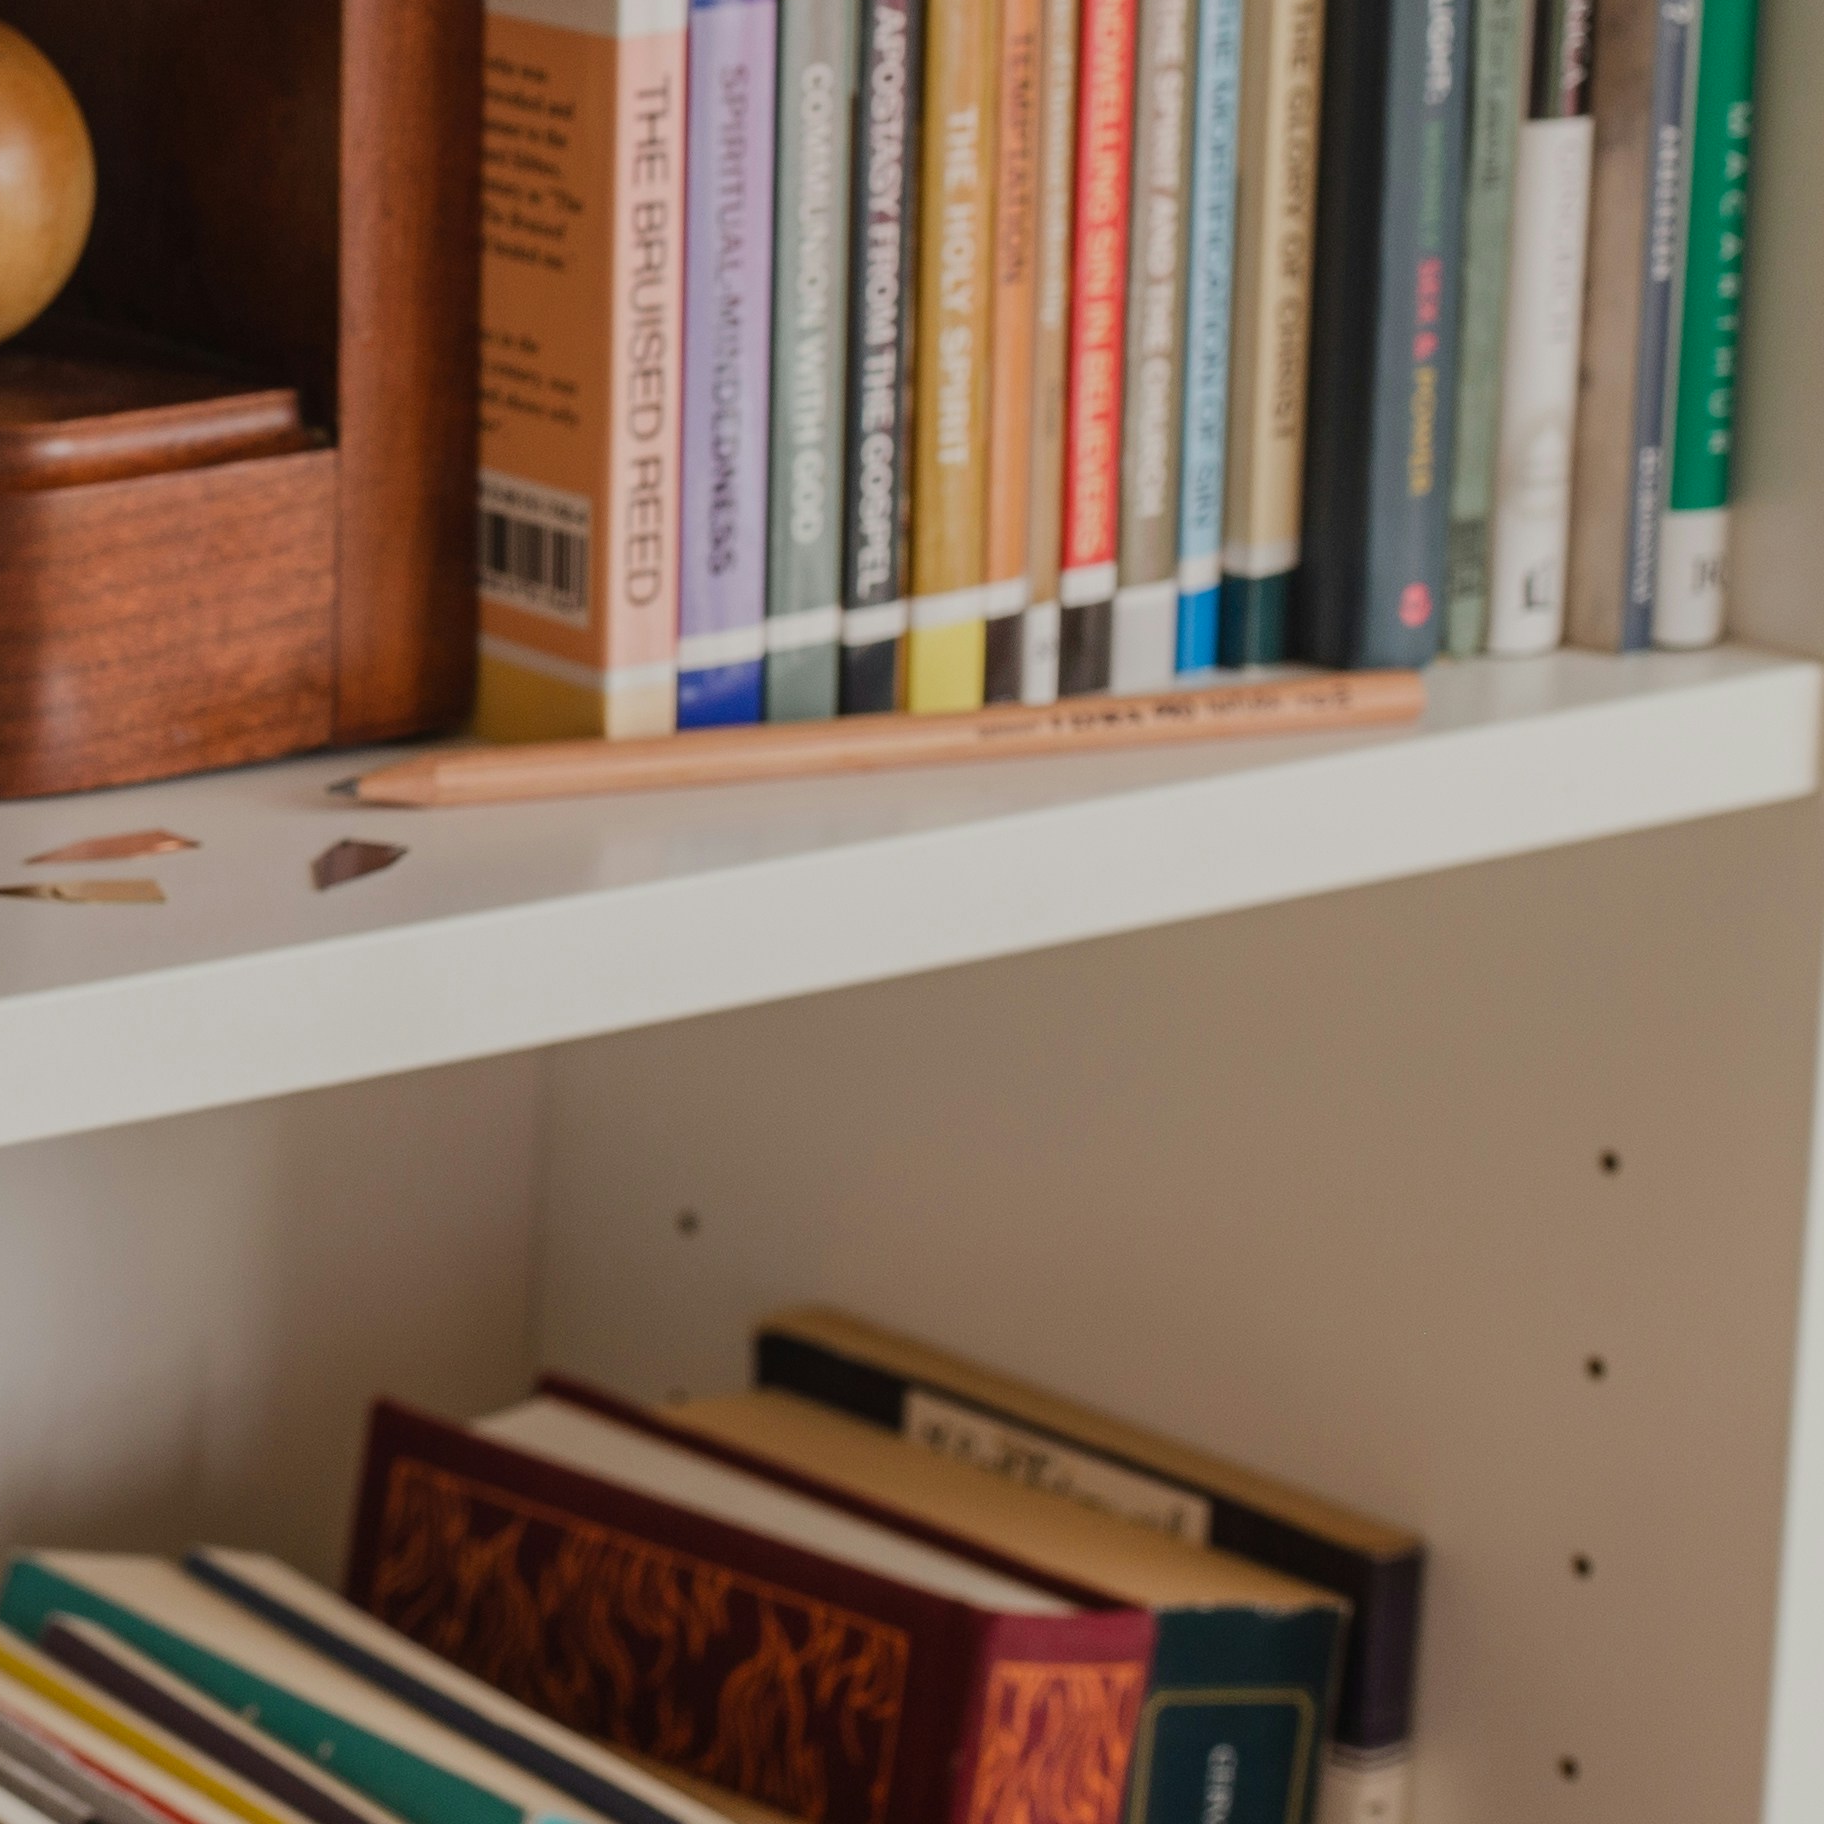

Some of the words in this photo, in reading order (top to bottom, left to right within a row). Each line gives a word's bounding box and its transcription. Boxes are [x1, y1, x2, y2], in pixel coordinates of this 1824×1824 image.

[1285, 0, 1316, 73] THE
[632, 75, 673, 185] THE
[866, 5, 906, 217] APOSTASY
[945, 103, 979, 186] THE
[1003, 31, 1035, 285] TEMPTATION
[1150, 70, 1185, 188] SPIRIT
[1280, 84, 1312, 220] GLORY
[795, 62, 836, 328] COMMUNION
[1146, 196, 1179, 272] AND
[1194, 82, 1237, 376] MORTIFICATION
[862, 223, 901, 346] FROM
[936, 203, 976, 319] HOLY
[1085, 228, 1118, 289] SIN
[1143, 283, 1176, 348] THE
[1278, 231, 1305, 281] OF
[1704, 102, 1752, 456] MACARTHUR
[627, 200, 669, 444] BRUISED
[705, 63, 750, 576] SPIRITUAL-MINDEDNESS
[1083, 302, 1116, 344] IN
[1271, 296, 1302, 441] CHRIST
[790, 337, 826, 444] WITH
[861, 351, 898, 429] THE
[935, 327, 973, 468] SPIRIT
[1136, 358, 1173, 518] CHURCH
[1194, 385, 1225, 443] OF
[787, 450, 824, 546] GOD
[1073, 350, 1115, 558] BELIEVERS
[1191, 459, 1220, 527] SIN
[624, 456, 662, 607] REED
[855, 434, 893, 599] GOSPEL
